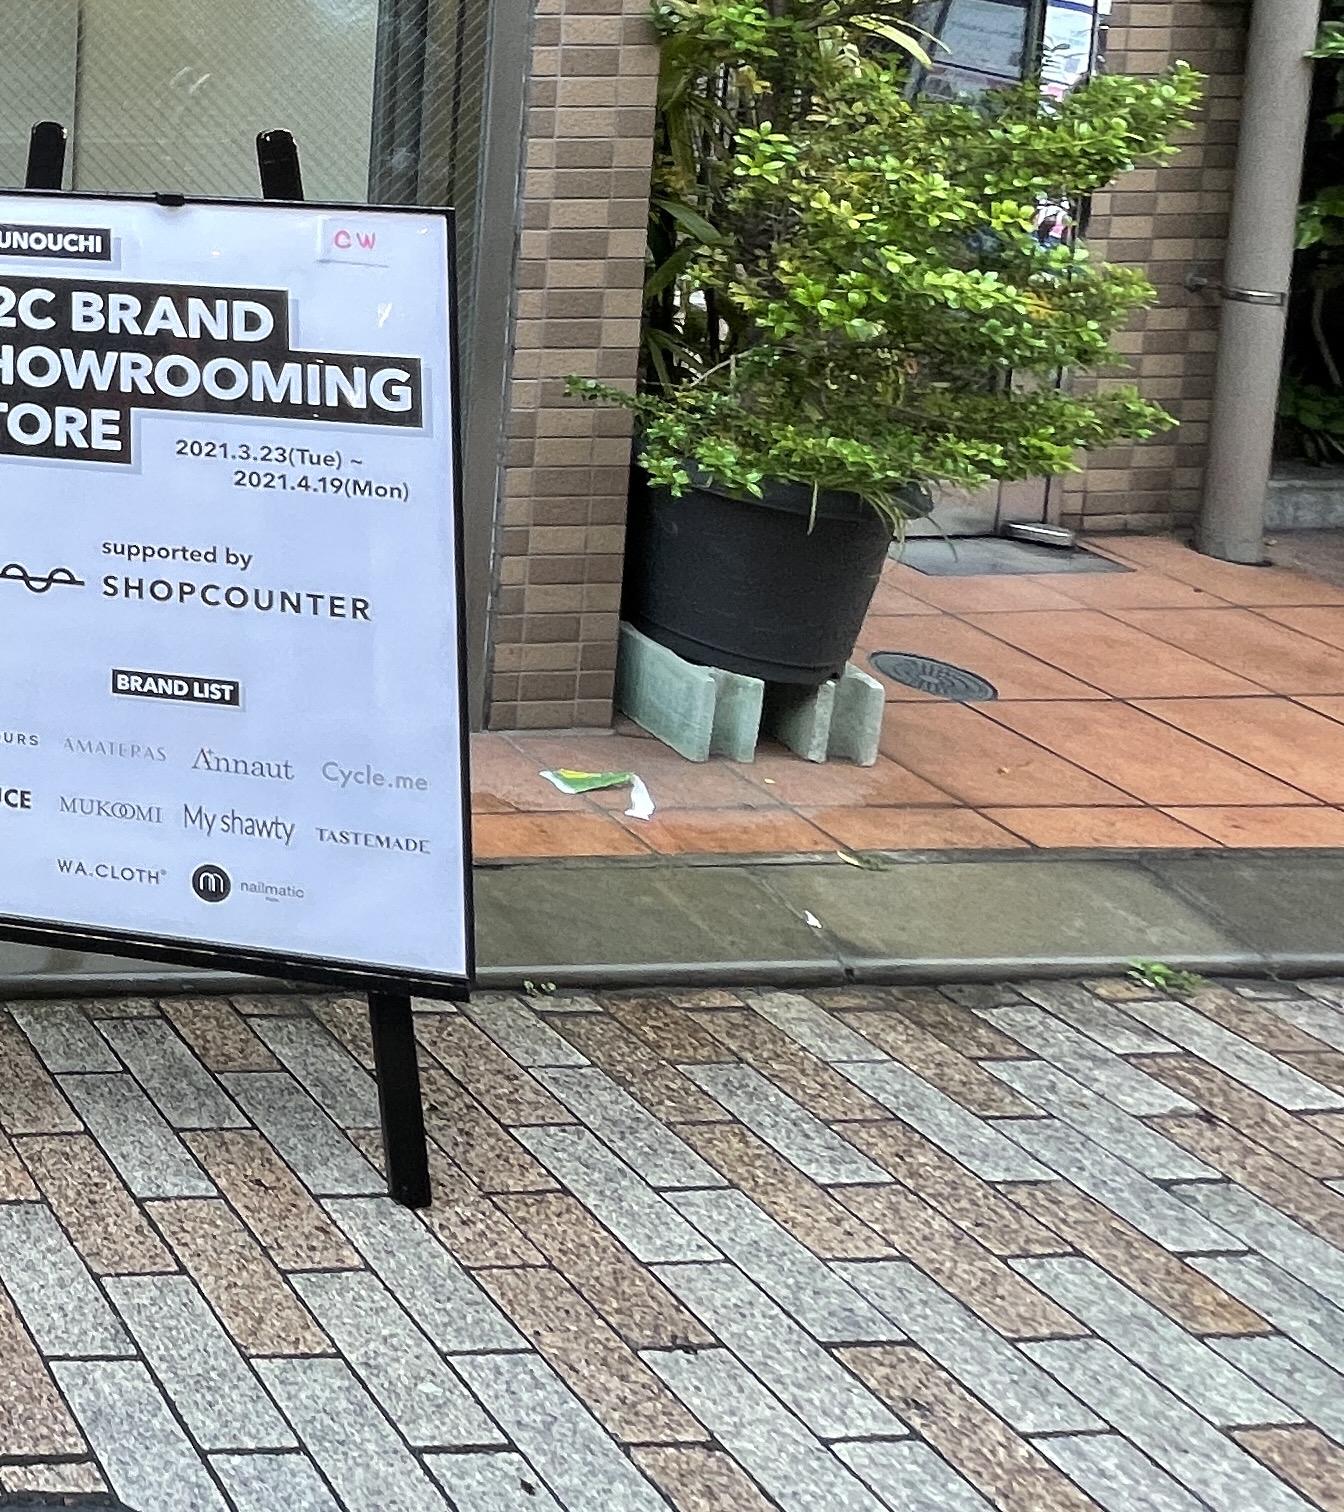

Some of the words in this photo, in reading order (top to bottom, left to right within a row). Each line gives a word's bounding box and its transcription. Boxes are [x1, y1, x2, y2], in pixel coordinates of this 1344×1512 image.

[71, 291, 275, 343] BRAND
[175, 439, 342, 470] 2021.3.23(Tue)
[233, 469, 410, 502] 2021.4.19(Mon)
[101, 541, 217, 565] supported
[225, 546, 253, 571] by
[102, 575, 372, 621] SHOPCOUNTER
[116, 673, 189, 698] BRAND
[192, 679, 234, 702] LIST
[63, 737, 167, 762] AMATERAS
[322, 761, 429, 790] Cycle.me
[315, 827, 431, 854] TASTEMADE
[240, 881, 305, 899] nailmatic
